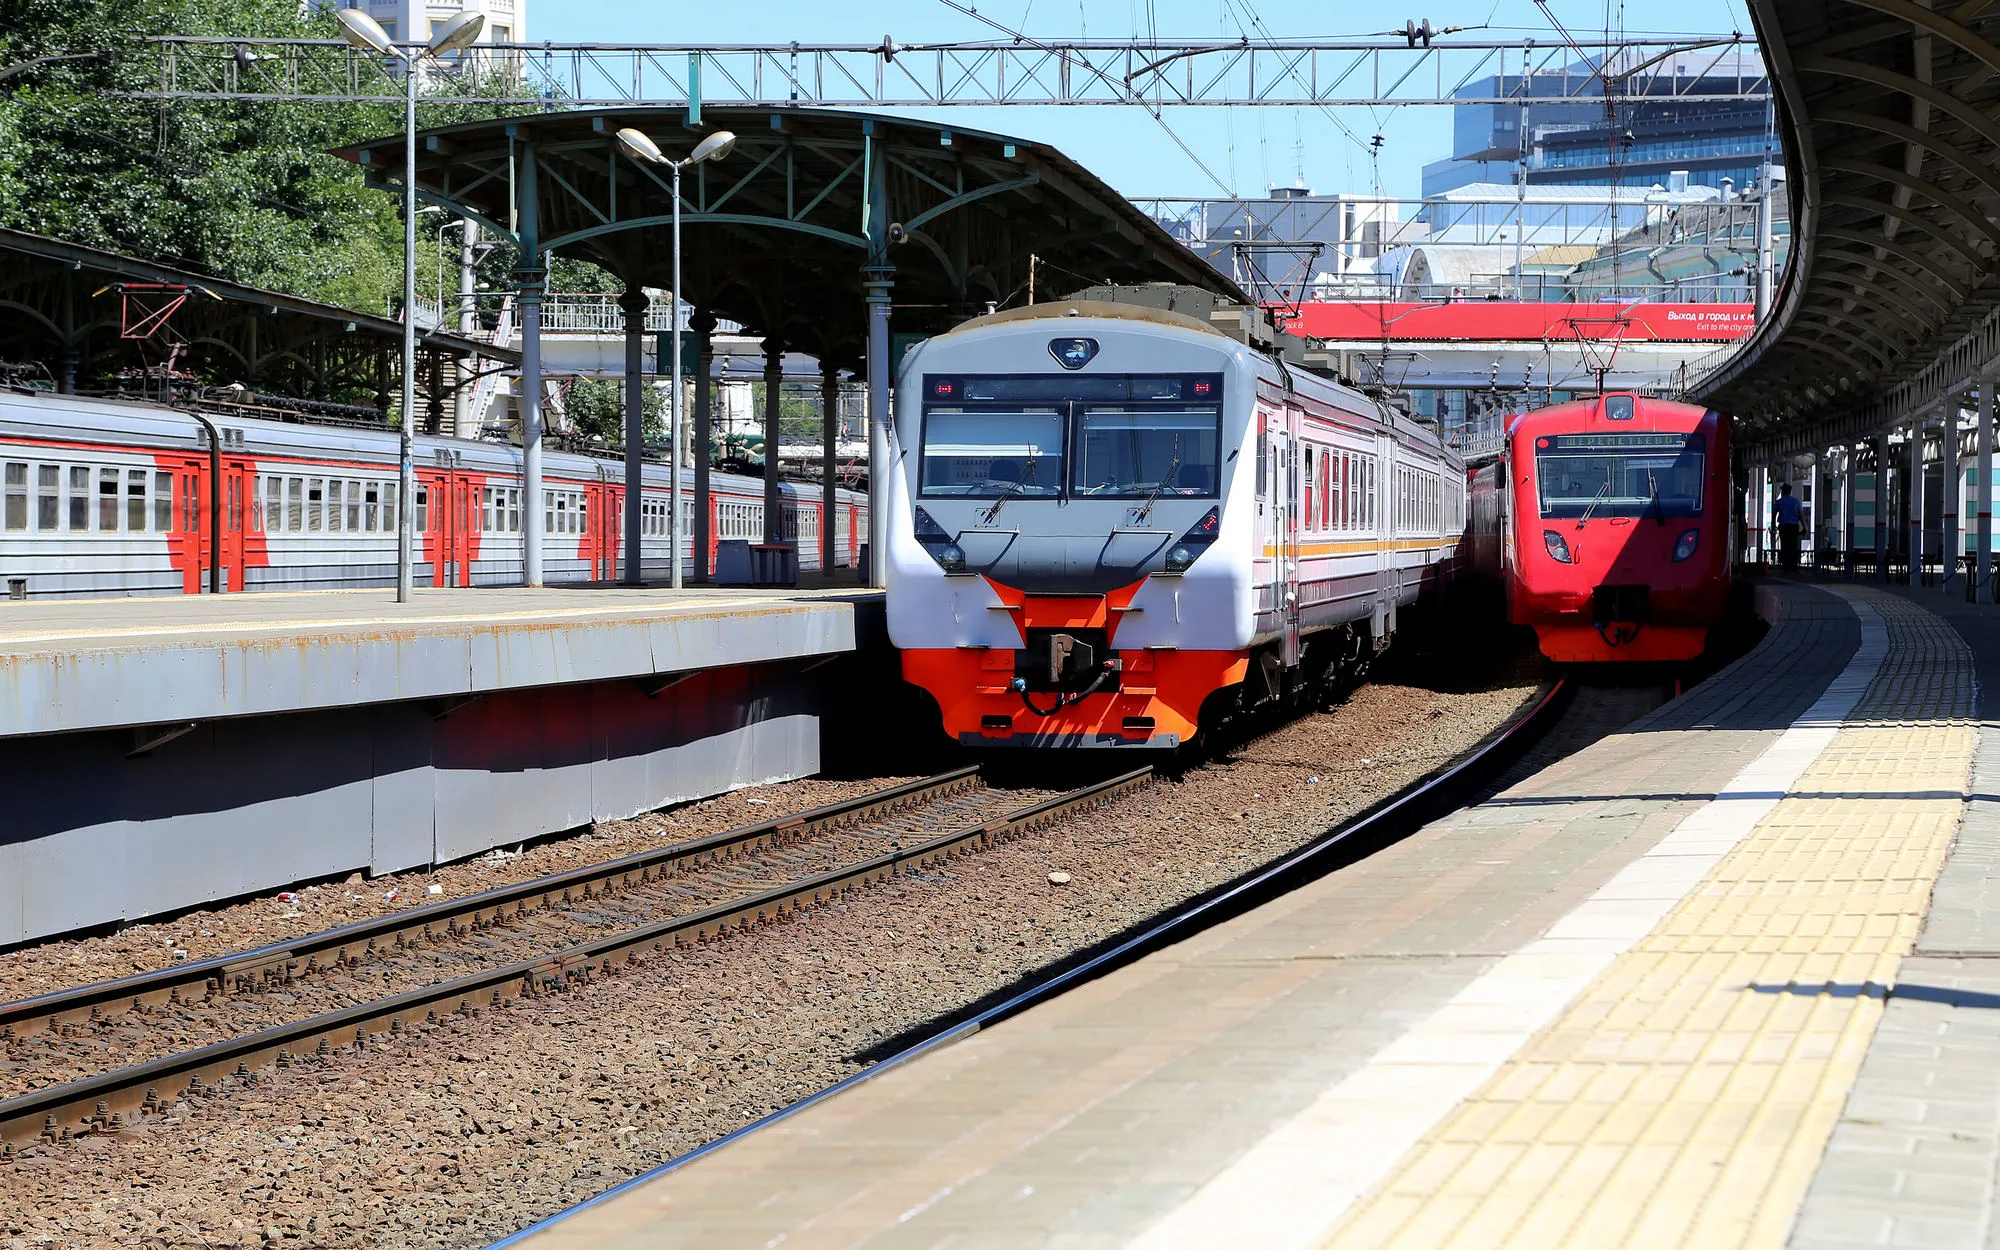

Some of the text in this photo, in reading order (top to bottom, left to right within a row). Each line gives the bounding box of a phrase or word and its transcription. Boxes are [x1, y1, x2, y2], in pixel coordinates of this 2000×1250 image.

[1668, 311, 1697, 320] Выход
[1698, 312, 1705, 321] в
[1705, 312, 1731, 323] город
[1732, 313, 1739, 321] и
[1740, 313, 1746, 321] к
[1730, 323, 1743, 332] city
